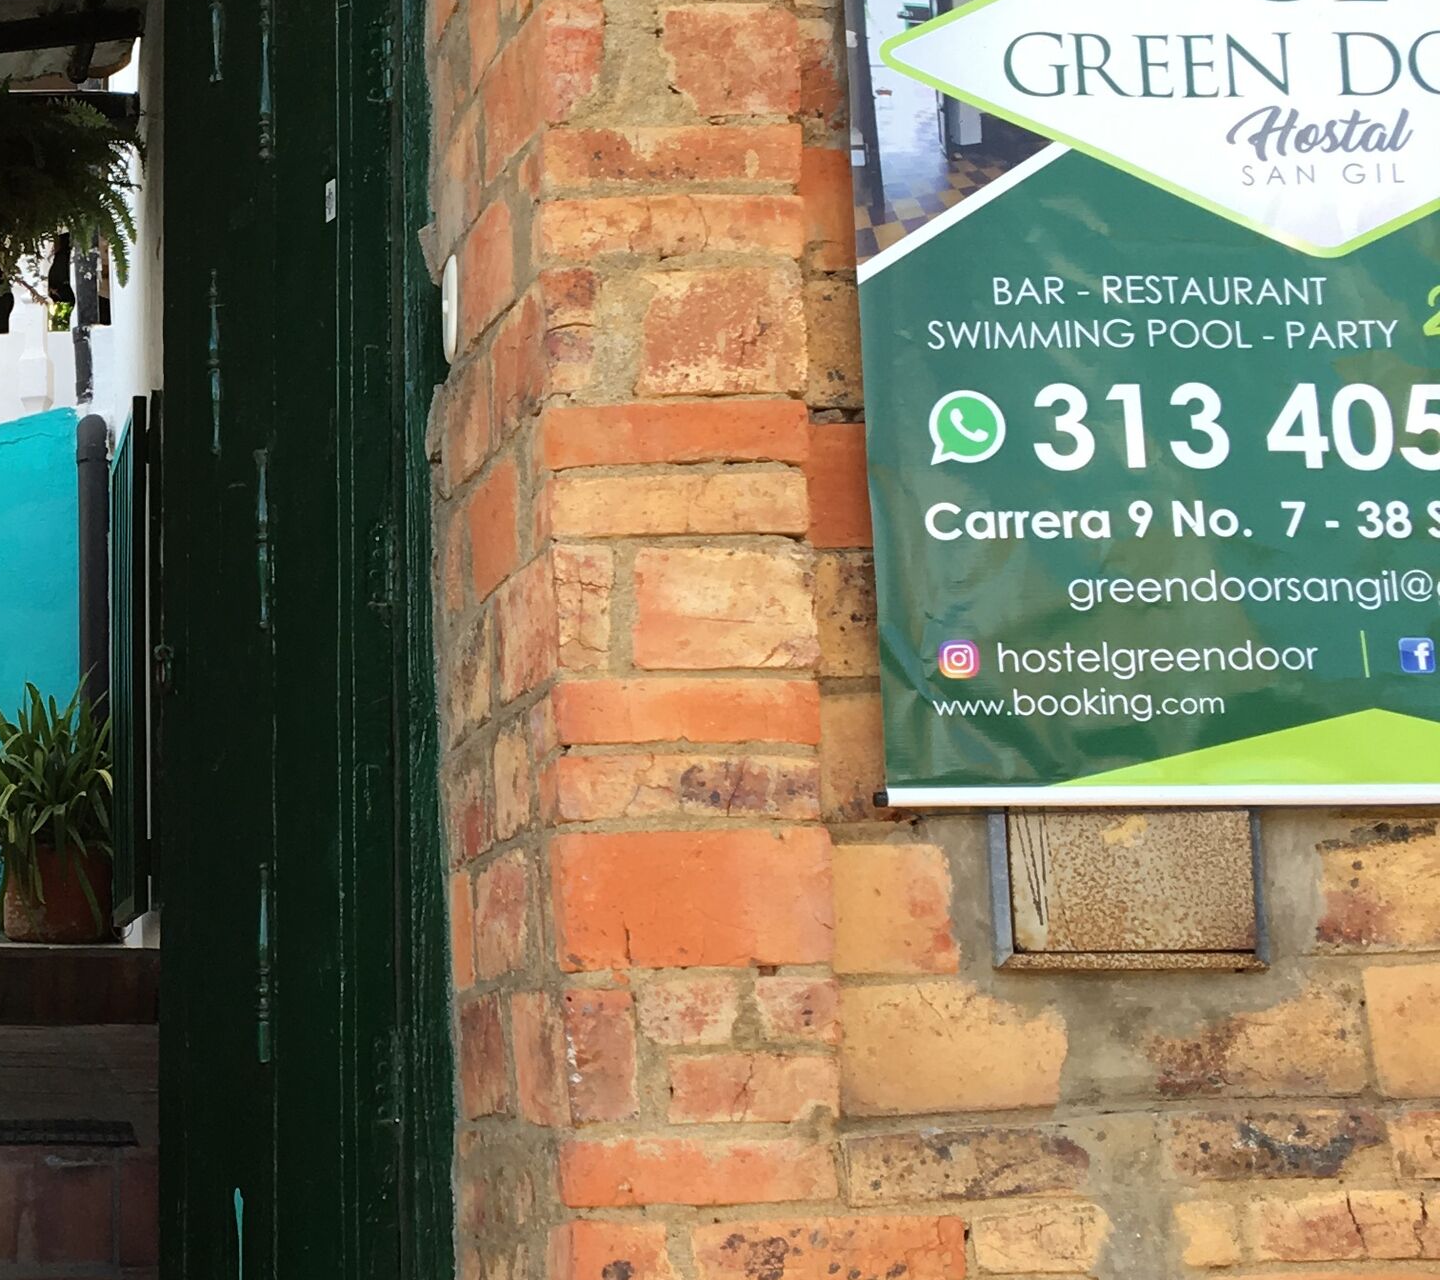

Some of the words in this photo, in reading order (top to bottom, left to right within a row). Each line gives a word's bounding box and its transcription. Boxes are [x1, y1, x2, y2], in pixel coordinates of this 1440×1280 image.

[1003, 31, 1291, 99] GREEN
[1225, 105, 1414, 162] Hostal
[1241, 164, 1315, 187] SAN
[1342, 162, 1406, 185] GIL
[992, 276, 1065, 306] BAR
[1102, 274, 1328, 306] RESTAURANT
[927, 318, 1135, 350] SWIMMING
[1147, 319, 1253, 349] POOL
[1285, 319, 1399, 350] PARTY
[1033, 382, 1230, 472] 313
[1266, 382, 1440, 471] 405
[924, 502, 1112, 541] Carrera
[1127, 500, 1153, 538] 9
[1171, 500, 1253, 538] No.
[1280, 500, 1306, 538] 7
[1357, 500, 1413, 539] 38
[1067, 569, 1440, 612] greendoorsangil@
[997, 639, 1319, 680] hostelgreendoor
[932, 687, 1225, 722] www.booking.com
